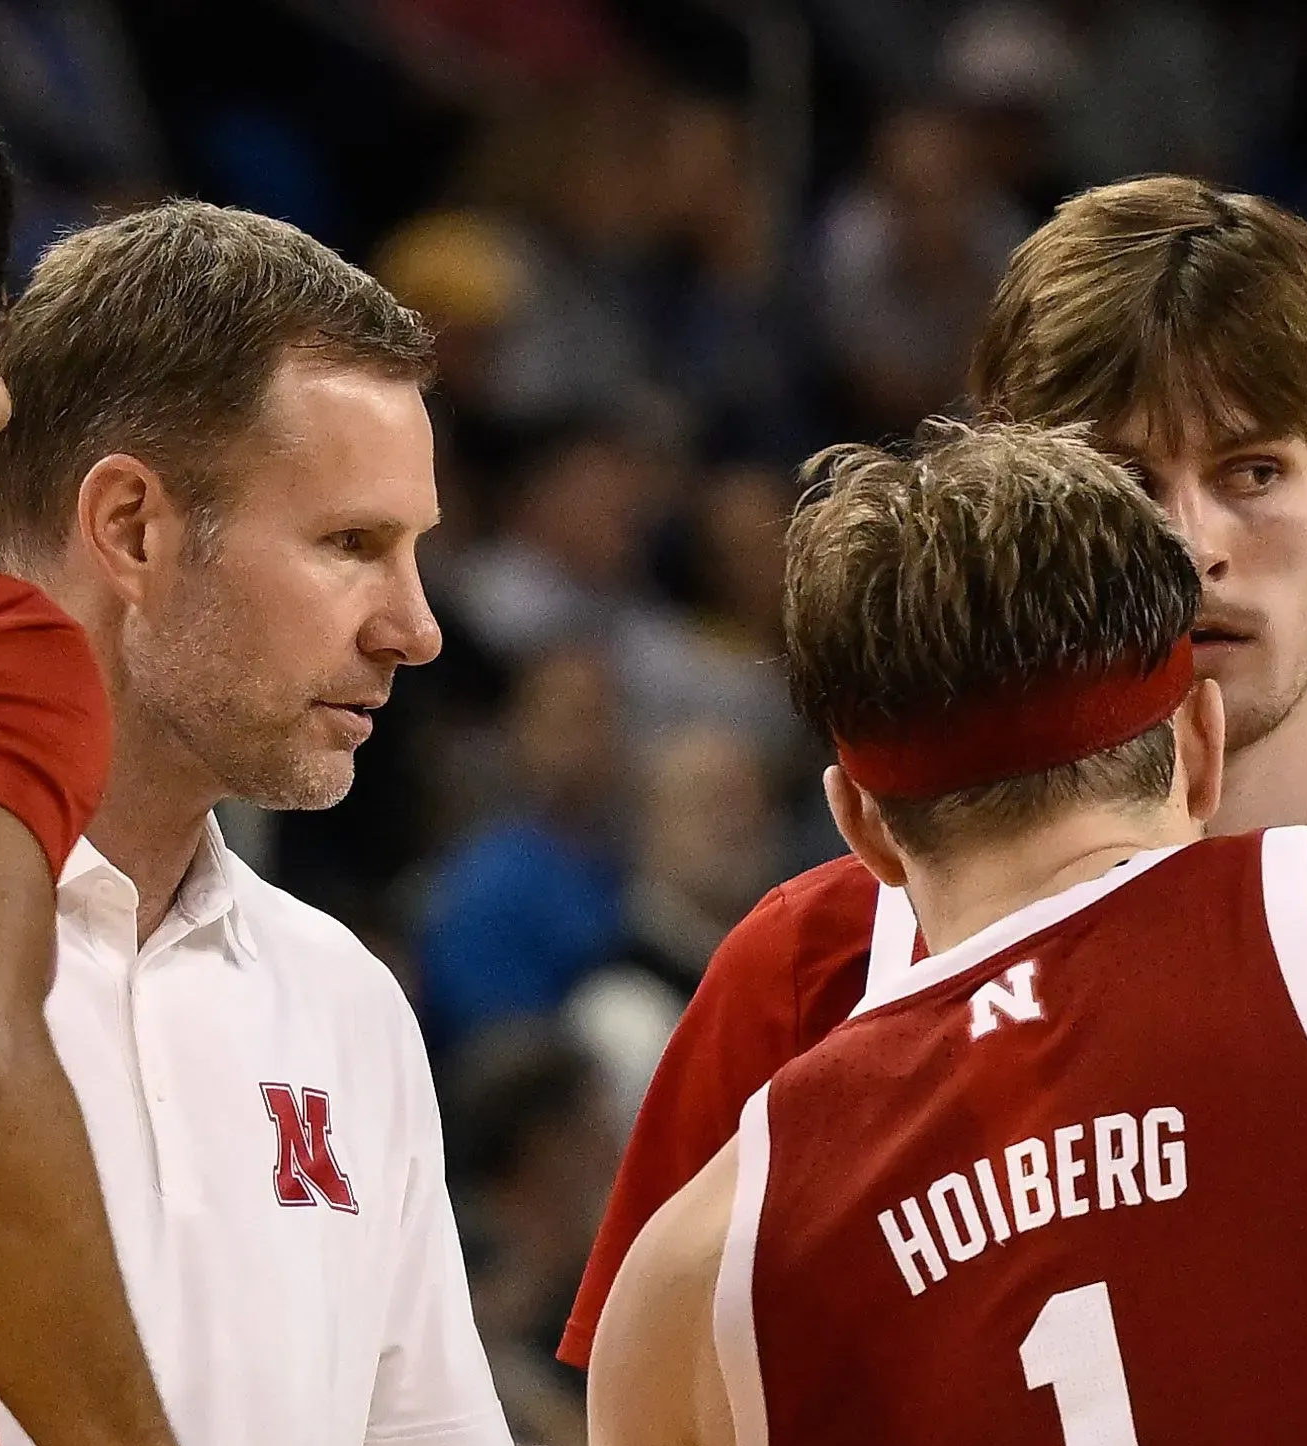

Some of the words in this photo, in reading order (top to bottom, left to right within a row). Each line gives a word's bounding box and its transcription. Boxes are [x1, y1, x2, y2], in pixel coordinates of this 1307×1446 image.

[968, 958, 1045, 1043] N
[259, 1081, 359, 1216] N
[877, 1106, 1188, 1297] HOIBERG
